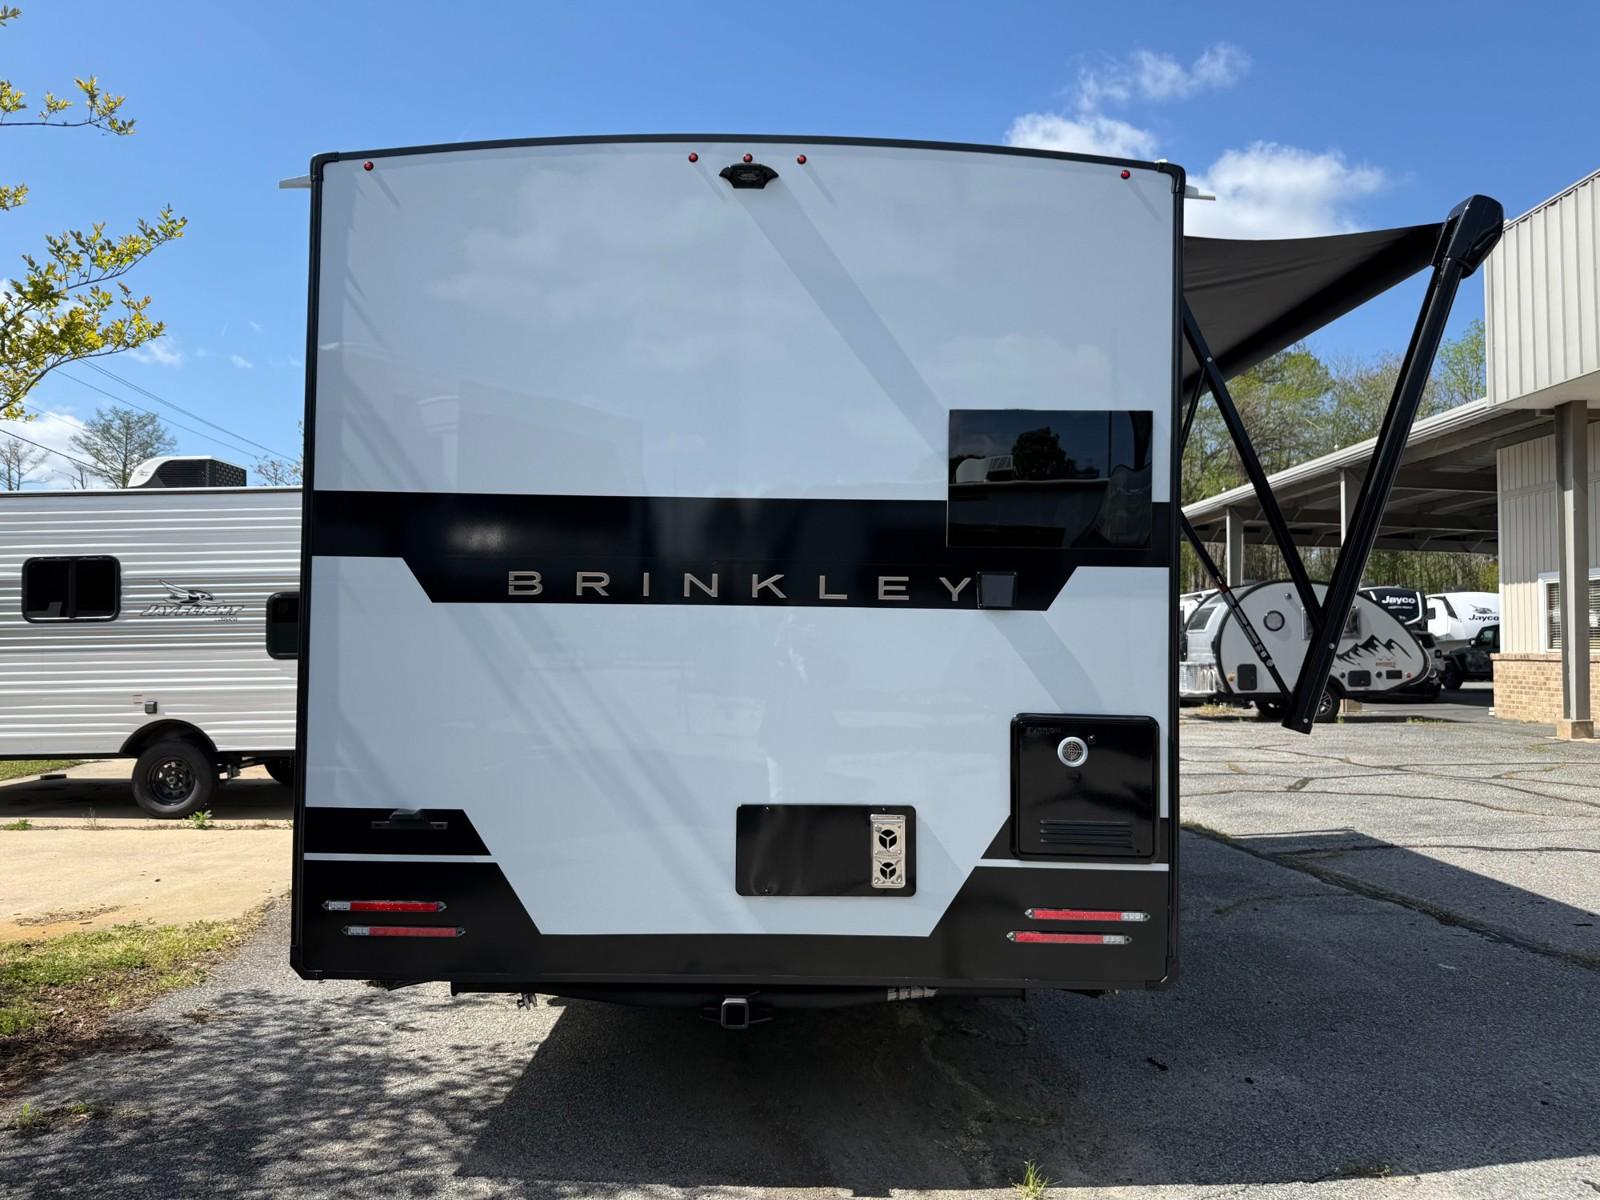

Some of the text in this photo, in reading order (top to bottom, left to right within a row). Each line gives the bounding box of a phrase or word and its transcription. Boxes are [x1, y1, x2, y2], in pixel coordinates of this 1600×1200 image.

[508, 571, 971, 602] BRINKLEY
[1381, 595, 1416, 605] Jayco
[1468, 614, 1499, 622] Jayco
